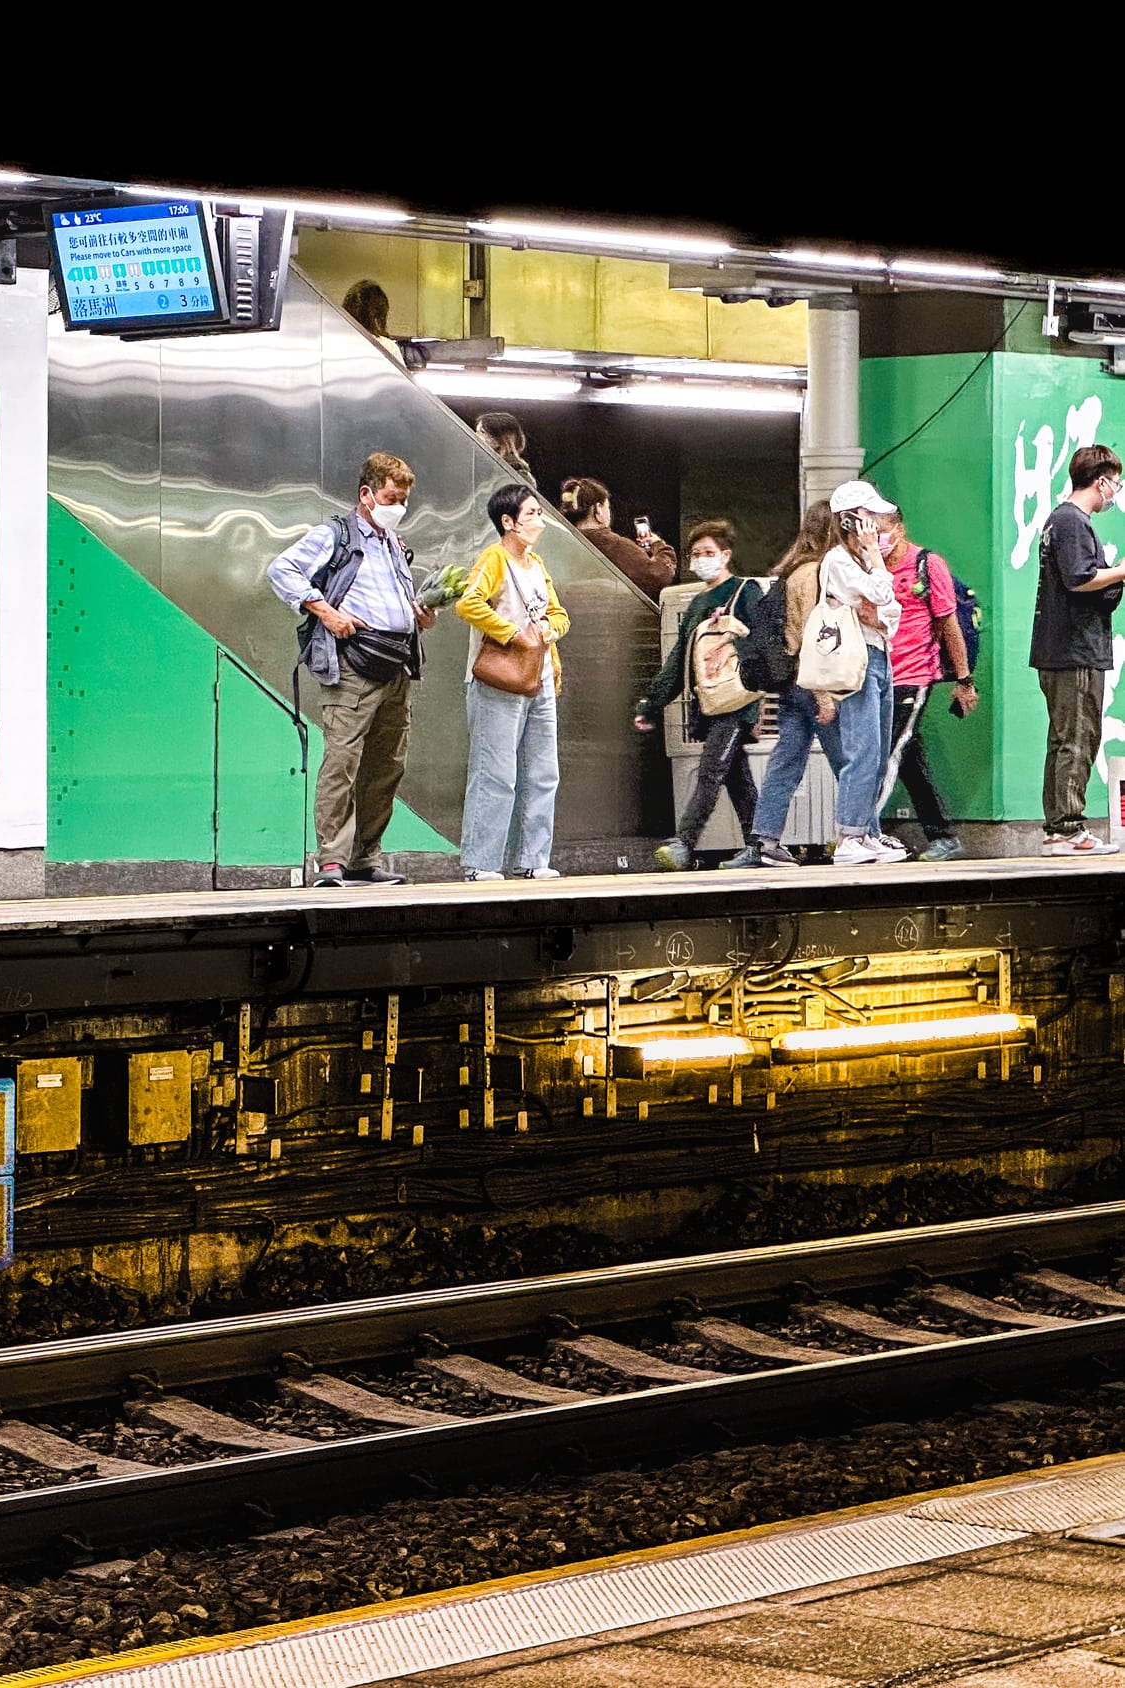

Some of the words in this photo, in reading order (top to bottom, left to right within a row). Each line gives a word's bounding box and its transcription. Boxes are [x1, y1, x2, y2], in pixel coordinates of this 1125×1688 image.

[169, 204, 189, 216] 17:06
[70, 251, 92, 262] Please
[93, 250, 111, 259] move
[112, 249, 120, 258] to
[121, 248, 136, 257] Cars
[137, 246, 152, 256] with
[153, 246, 171, 255] more
[172, 244, 192, 255] space
[75, 286, 80, 295] 1
[89, 285, 95, 294] 2
[105, 284, 110, 293] 3
[135, 282, 140, 290] 5
[149, 280, 155, 289] 6
[164, 279, 169, 288] 7
[179, 278, 184, 287] 8
[194, 277, 199, 286] 9
[74, 296, 118, 318] 落馬洲
[180, 294, 188, 307] 3
[191, 294, 210, 308] 分鐘
